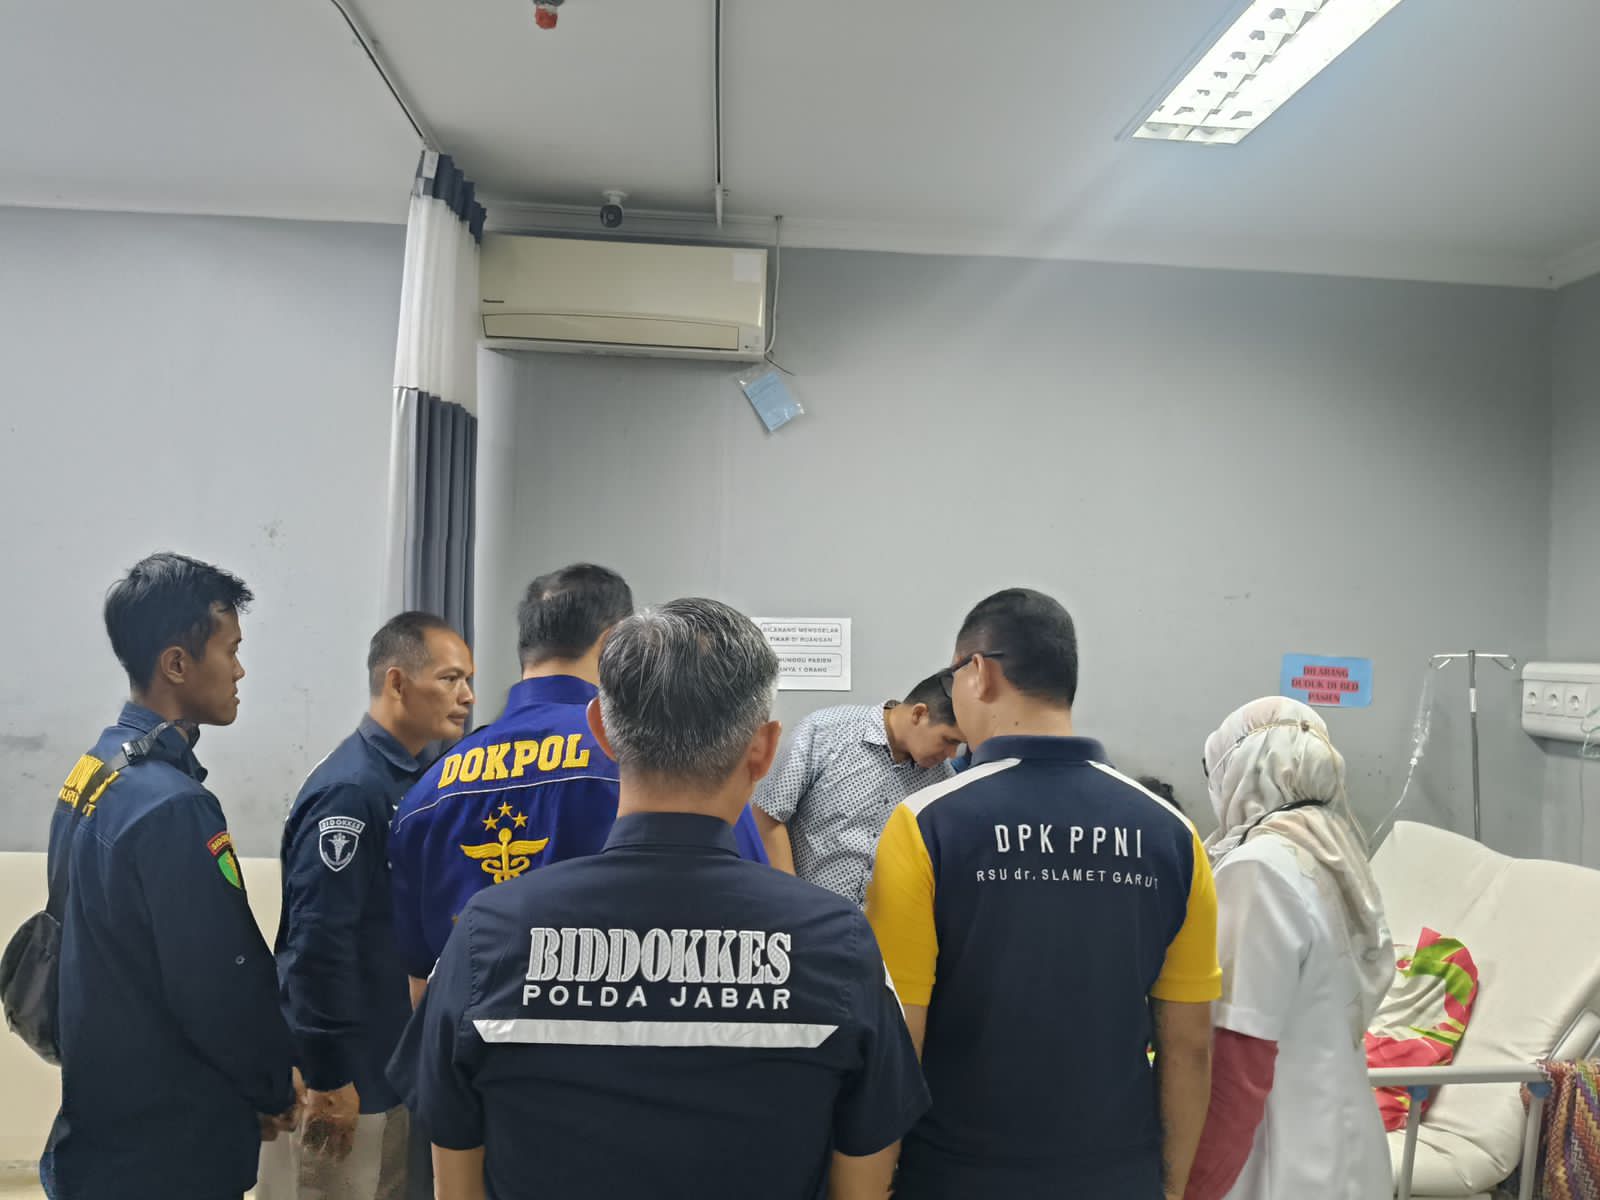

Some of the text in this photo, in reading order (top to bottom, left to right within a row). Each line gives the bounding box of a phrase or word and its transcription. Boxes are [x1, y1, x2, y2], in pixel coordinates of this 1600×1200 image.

[437, 733, 590, 789] DOKPOL
[994, 823, 1142, 858] DPK PPNI
[976, 868, 1159, 890] RSU dr. SLAMET GARUT
[525, 928, 792, 985] BIDDOKKES
[522, 985, 791, 1010] POLDA JABAR
